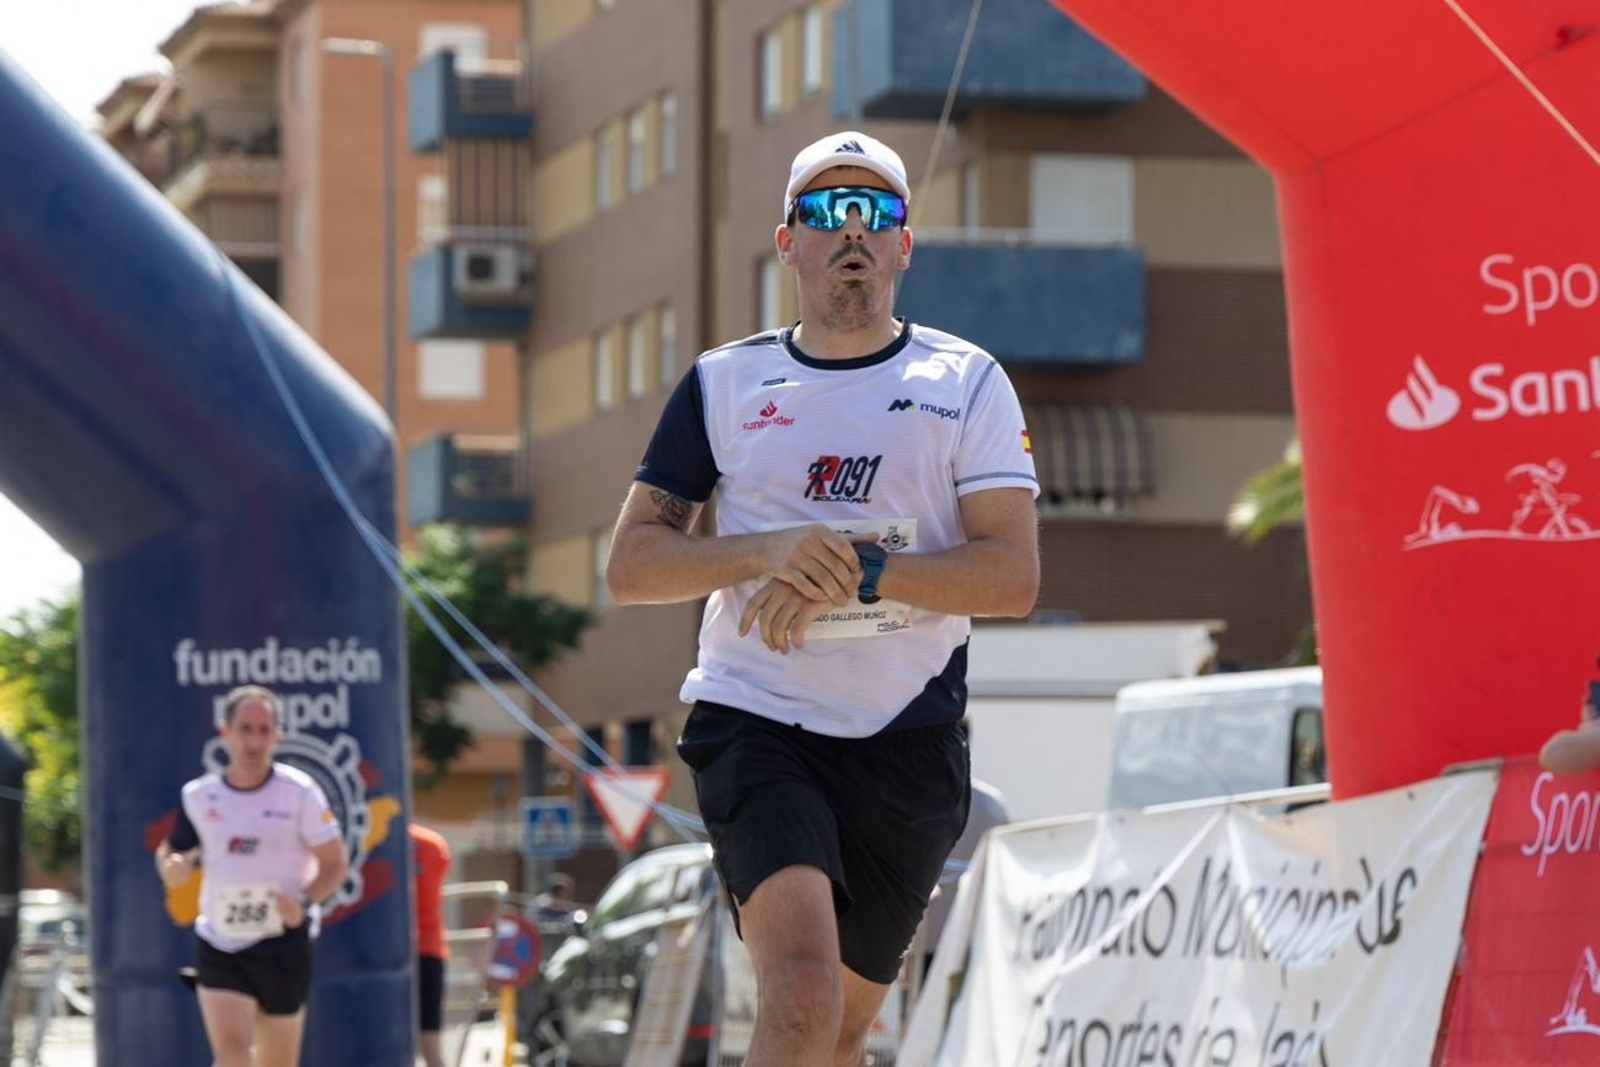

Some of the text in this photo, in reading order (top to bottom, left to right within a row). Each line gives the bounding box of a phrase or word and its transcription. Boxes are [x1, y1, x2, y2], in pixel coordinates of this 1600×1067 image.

[920, 404, 960, 420] mupol
[830, 610, 863, 621] GALLEGO
[864, 609, 887, 619] MUÑOZ
[173, 636, 381, 686] fundación
